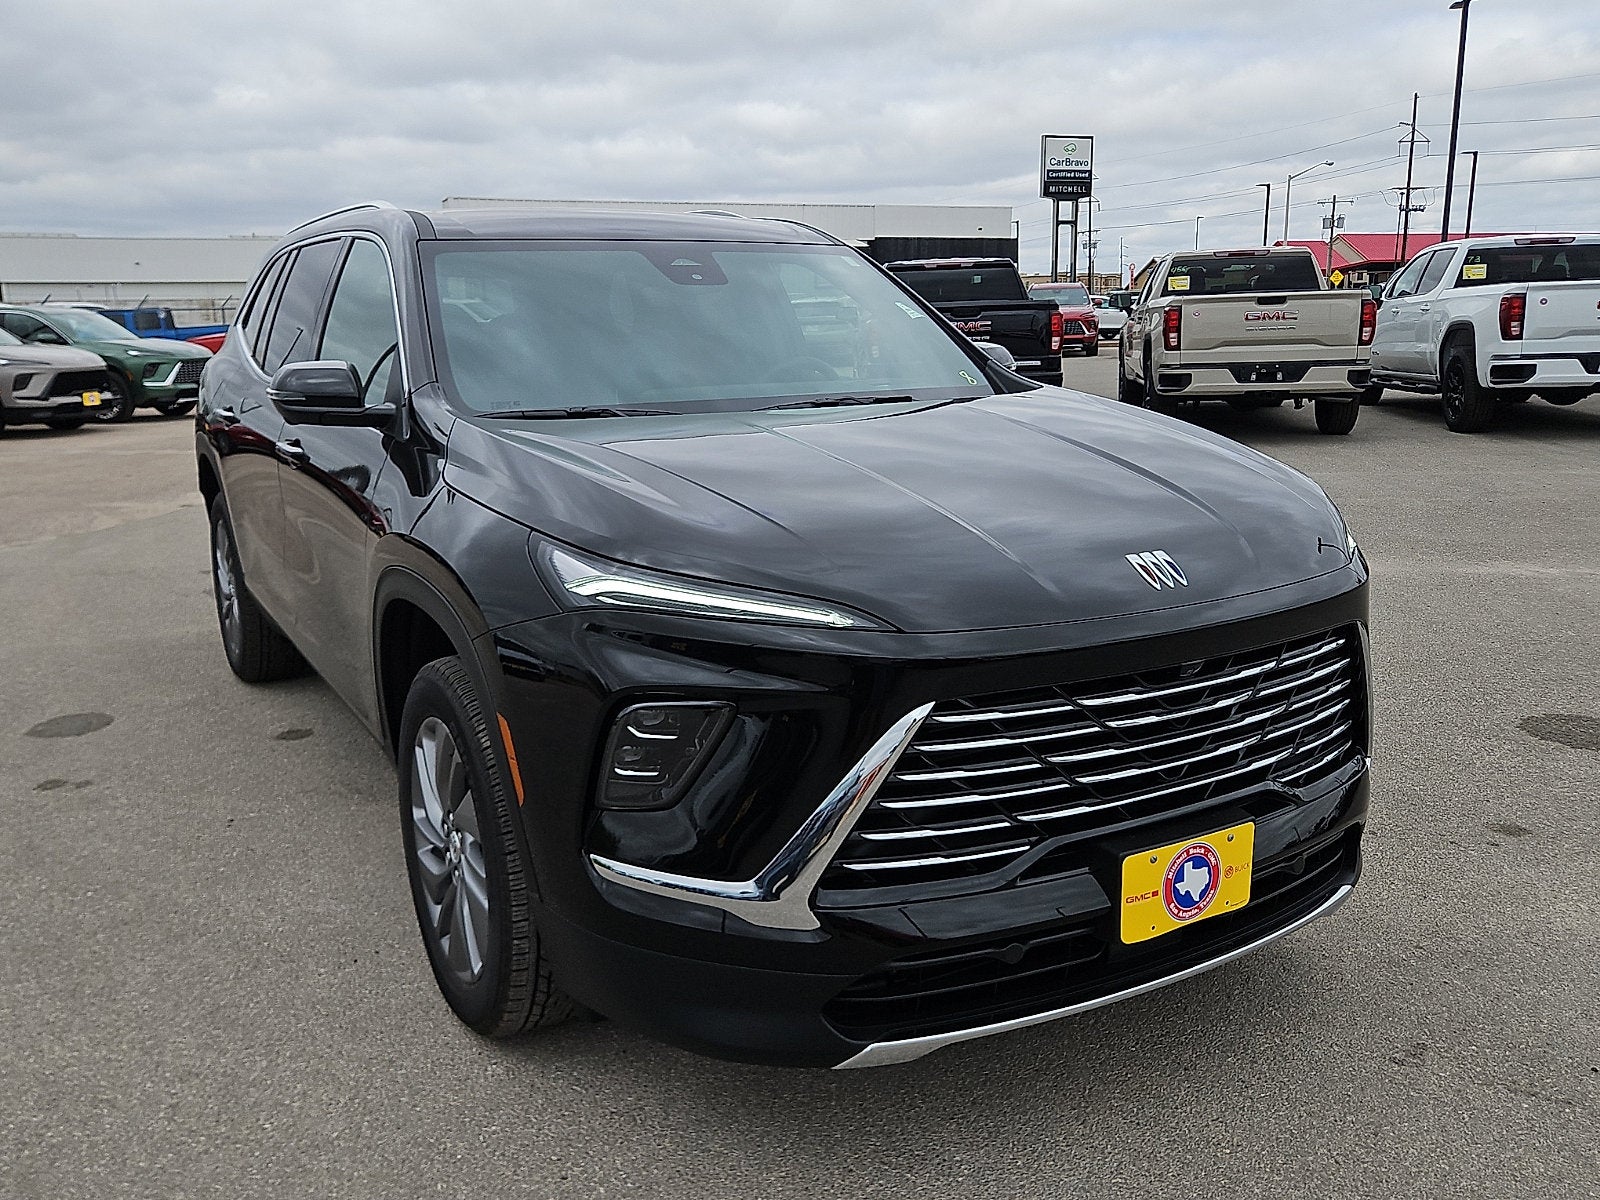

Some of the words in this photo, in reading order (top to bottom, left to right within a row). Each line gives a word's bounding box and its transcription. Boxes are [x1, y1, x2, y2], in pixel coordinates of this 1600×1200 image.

[1049, 157, 1089, 167] CarBravo
[1049, 185, 1087, 193] MITCHELL
[1244, 310, 1298, 321] GMC
[1126, 891, 1151, 904] GMC
